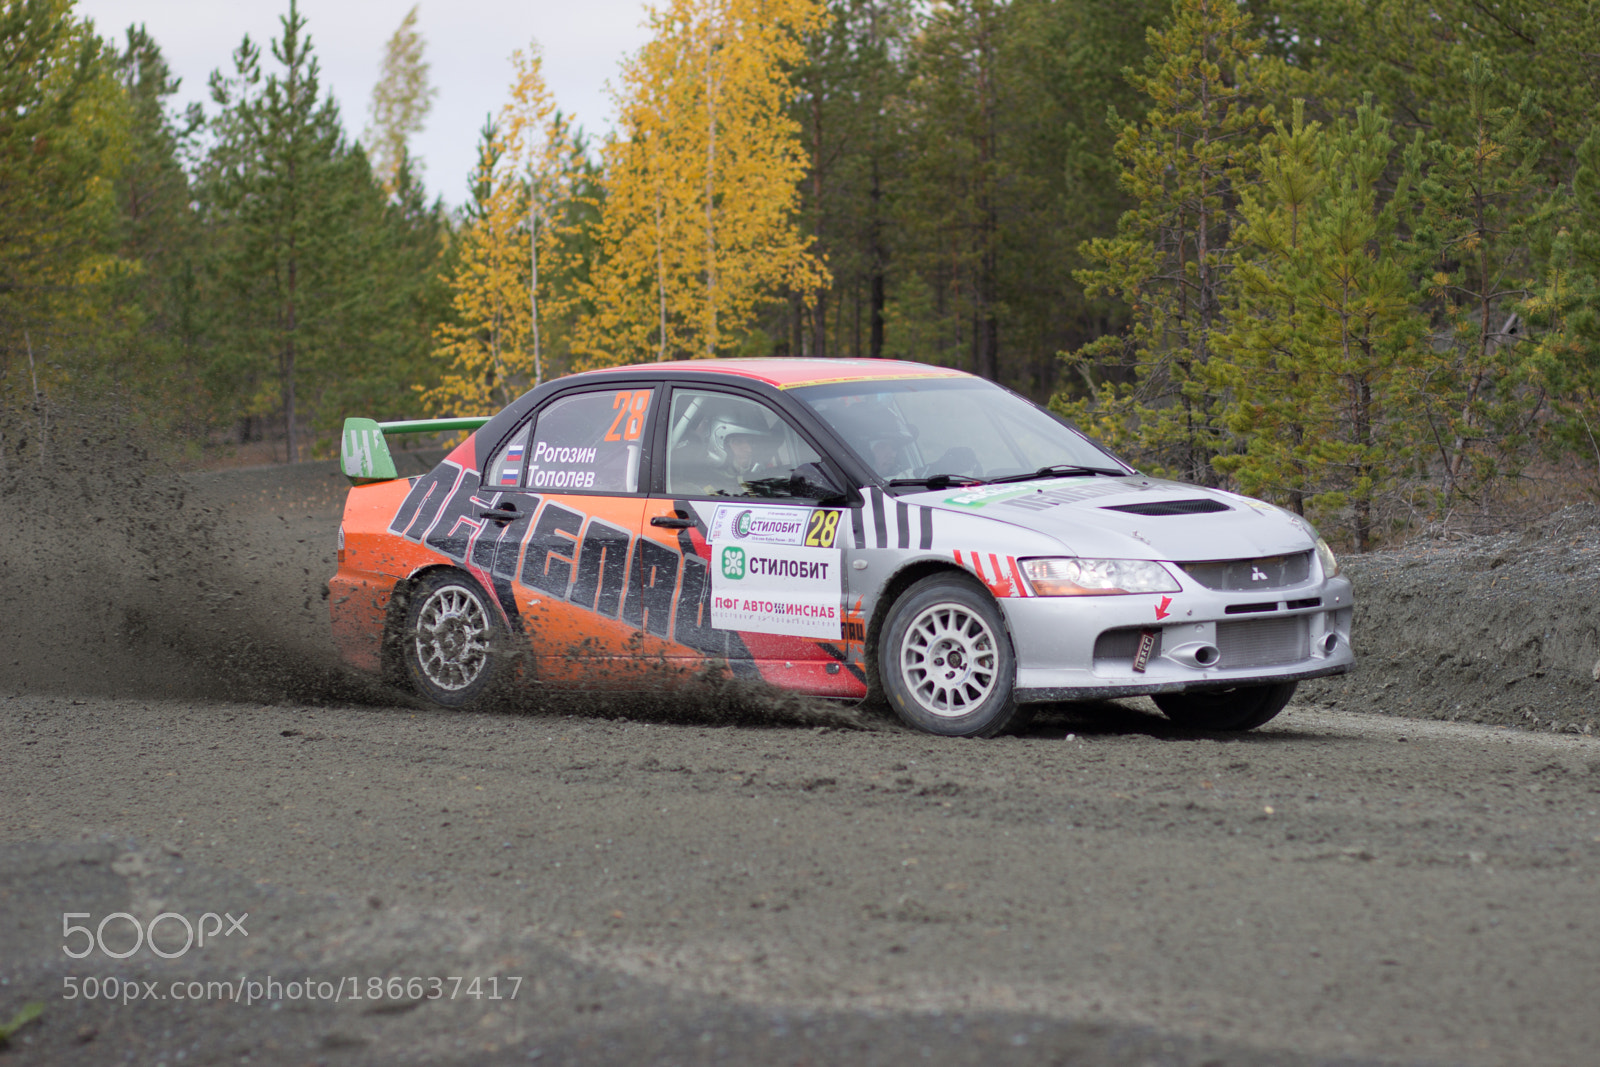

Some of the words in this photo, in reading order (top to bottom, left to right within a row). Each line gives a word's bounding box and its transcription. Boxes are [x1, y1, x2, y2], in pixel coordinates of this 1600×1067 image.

[604, 390, 650, 442] 28
[534, 441, 597, 463] Рогозин
[528, 465, 596, 488] Тополев
[750, 520, 802, 534] СТИЛОБИТ
[803, 510, 839, 547] 28
[749, 557, 829, 580] СТИЛОБИТ
[715, 597, 739, 610] ПФГ
